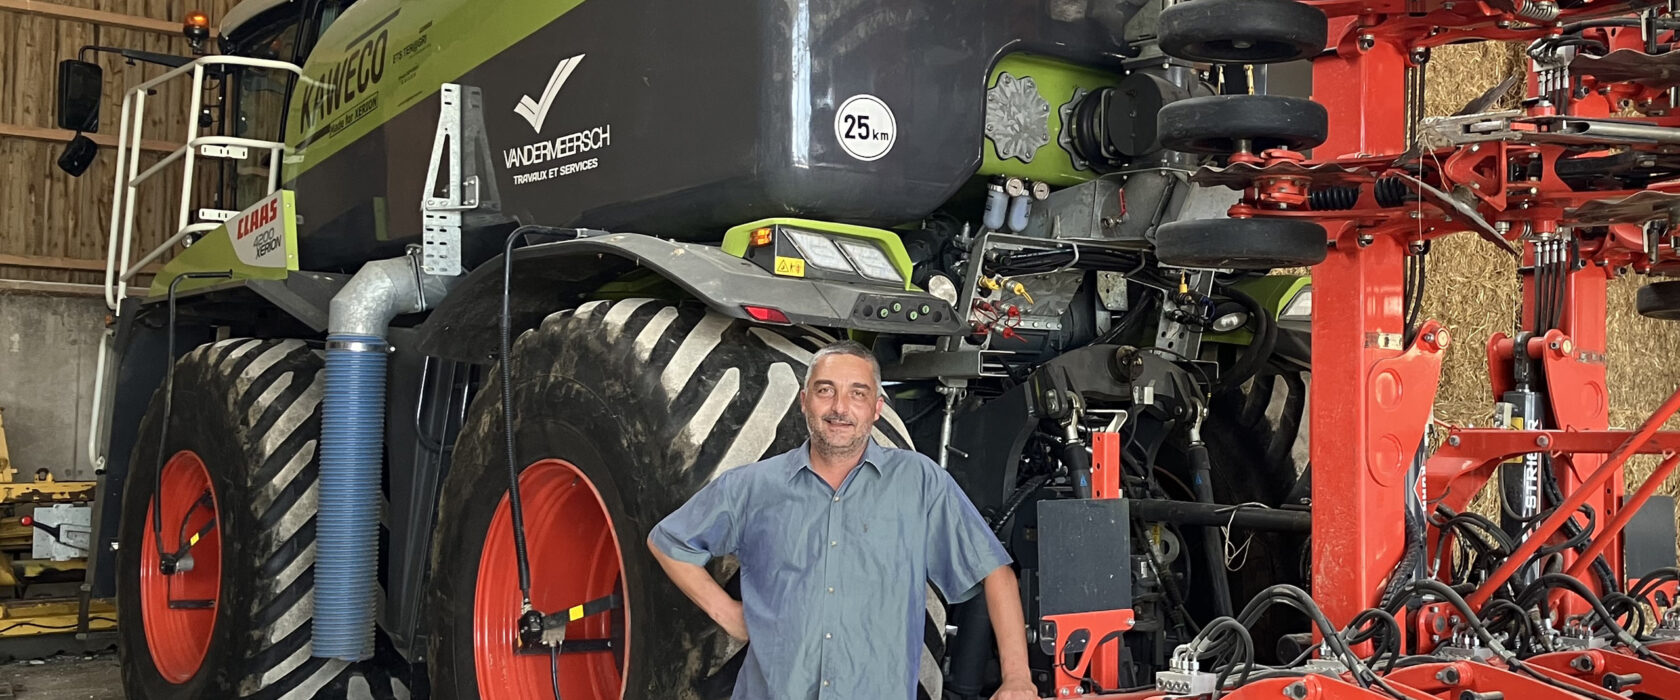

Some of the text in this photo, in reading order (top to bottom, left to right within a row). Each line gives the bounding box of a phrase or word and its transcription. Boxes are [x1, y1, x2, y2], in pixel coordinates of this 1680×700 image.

[300, 29, 388, 134] KAWECO
[345, 111, 354, 124] for
[355, 96, 378, 119] XERION
[844, 114, 889, 141] 25 km
[503, 124, 611, 169] VANDERMEERSCH
[513, 158, 599, 185] TRAVAUX ET SERVICES
[237, 197, 278, 240] CLAAS
[253, 227, 275, 247] 4200
[255, 234, 282, 260] XERION
[1524, 418, 1540, 509] STRIR
